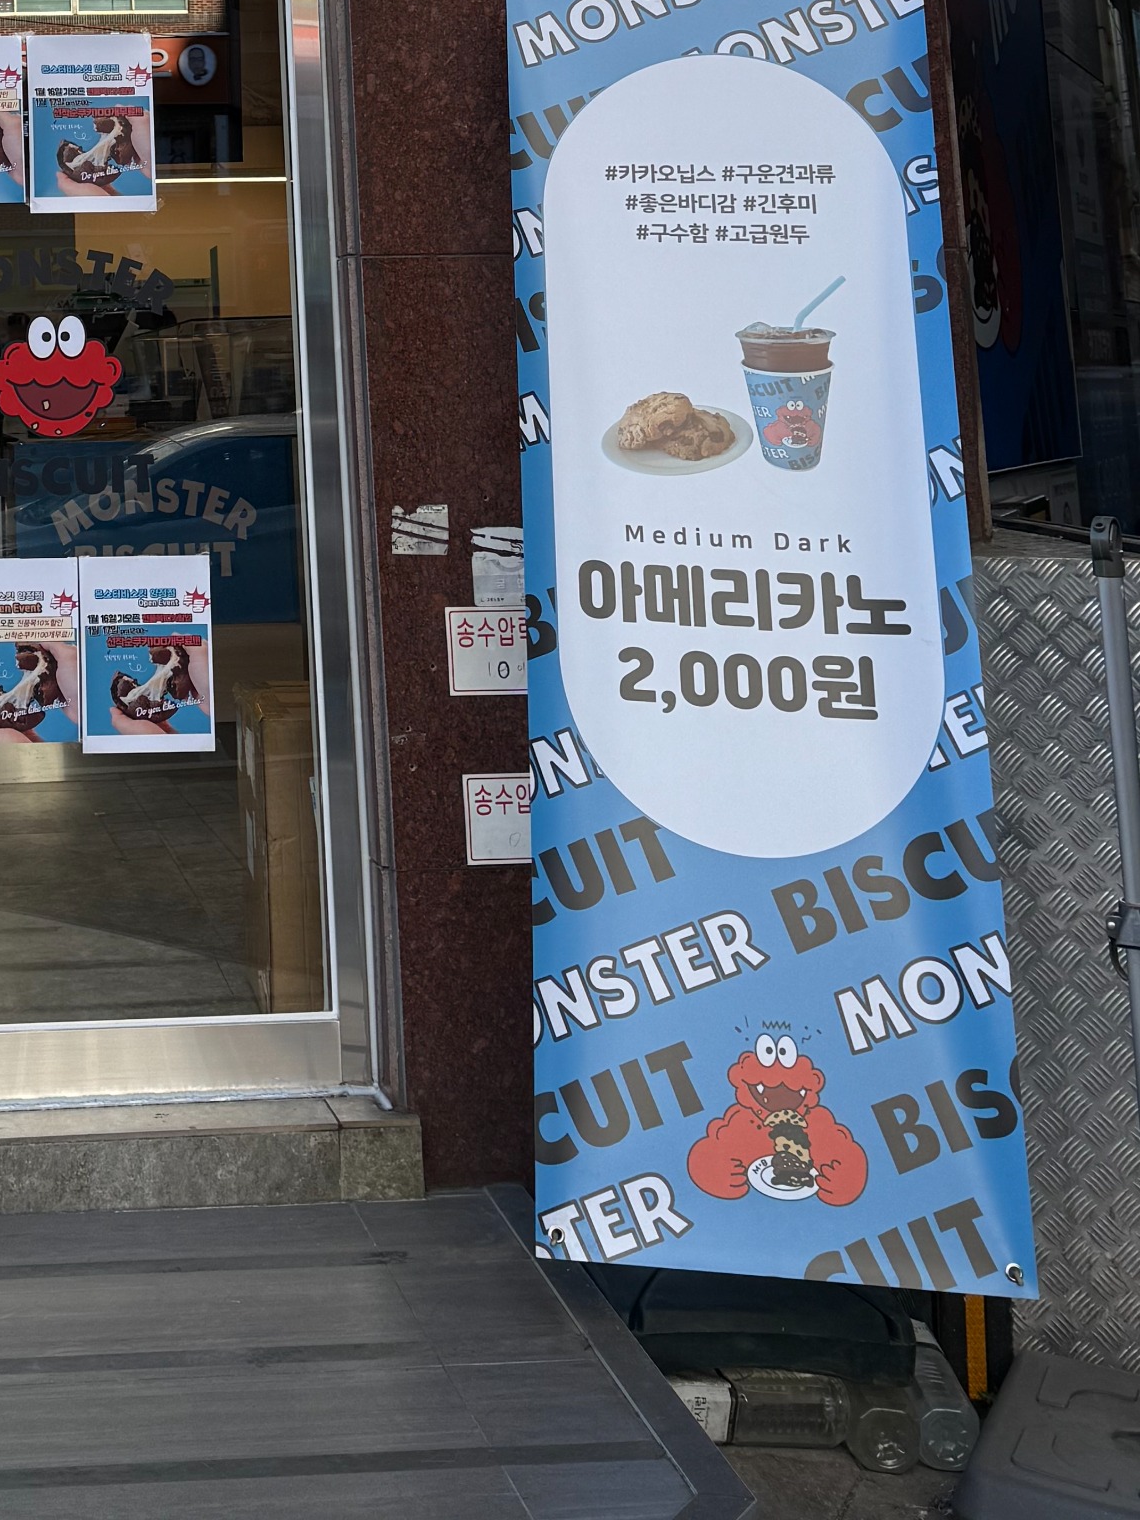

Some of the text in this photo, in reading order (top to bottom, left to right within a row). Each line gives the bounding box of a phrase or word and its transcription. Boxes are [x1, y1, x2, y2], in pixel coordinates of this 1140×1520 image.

[83, 73, 122, 82] Open Event
[80, 171, 92, 181] Do
[92, 169, 105, 182] you
[605, 164, 836, 184] #카카오닙스 #구운견과류
[625, 193, 817, 214] #좋은바디감 #긴후미
[636, 223, 810, 245] #구수함 #고급원두
[51, 477, 257, 546] MONSTER
[625, 525, 852, 554] Medium Dark
[12, 602, 42, 613] Event
[138, 598, 180, 608] Open Event
[578, 559, 912, 636] 아메리카노
[618, 646, 879, 720] 2,000원
[0, 709, 12, 720] Do
[13, 707, 27, 722] you
[136, 707, 147, 717] Do
[148, 705, 162, 719] you
[532, 910, 770, 1050] NSTER
[834, 931, 1013, 1055] MON
